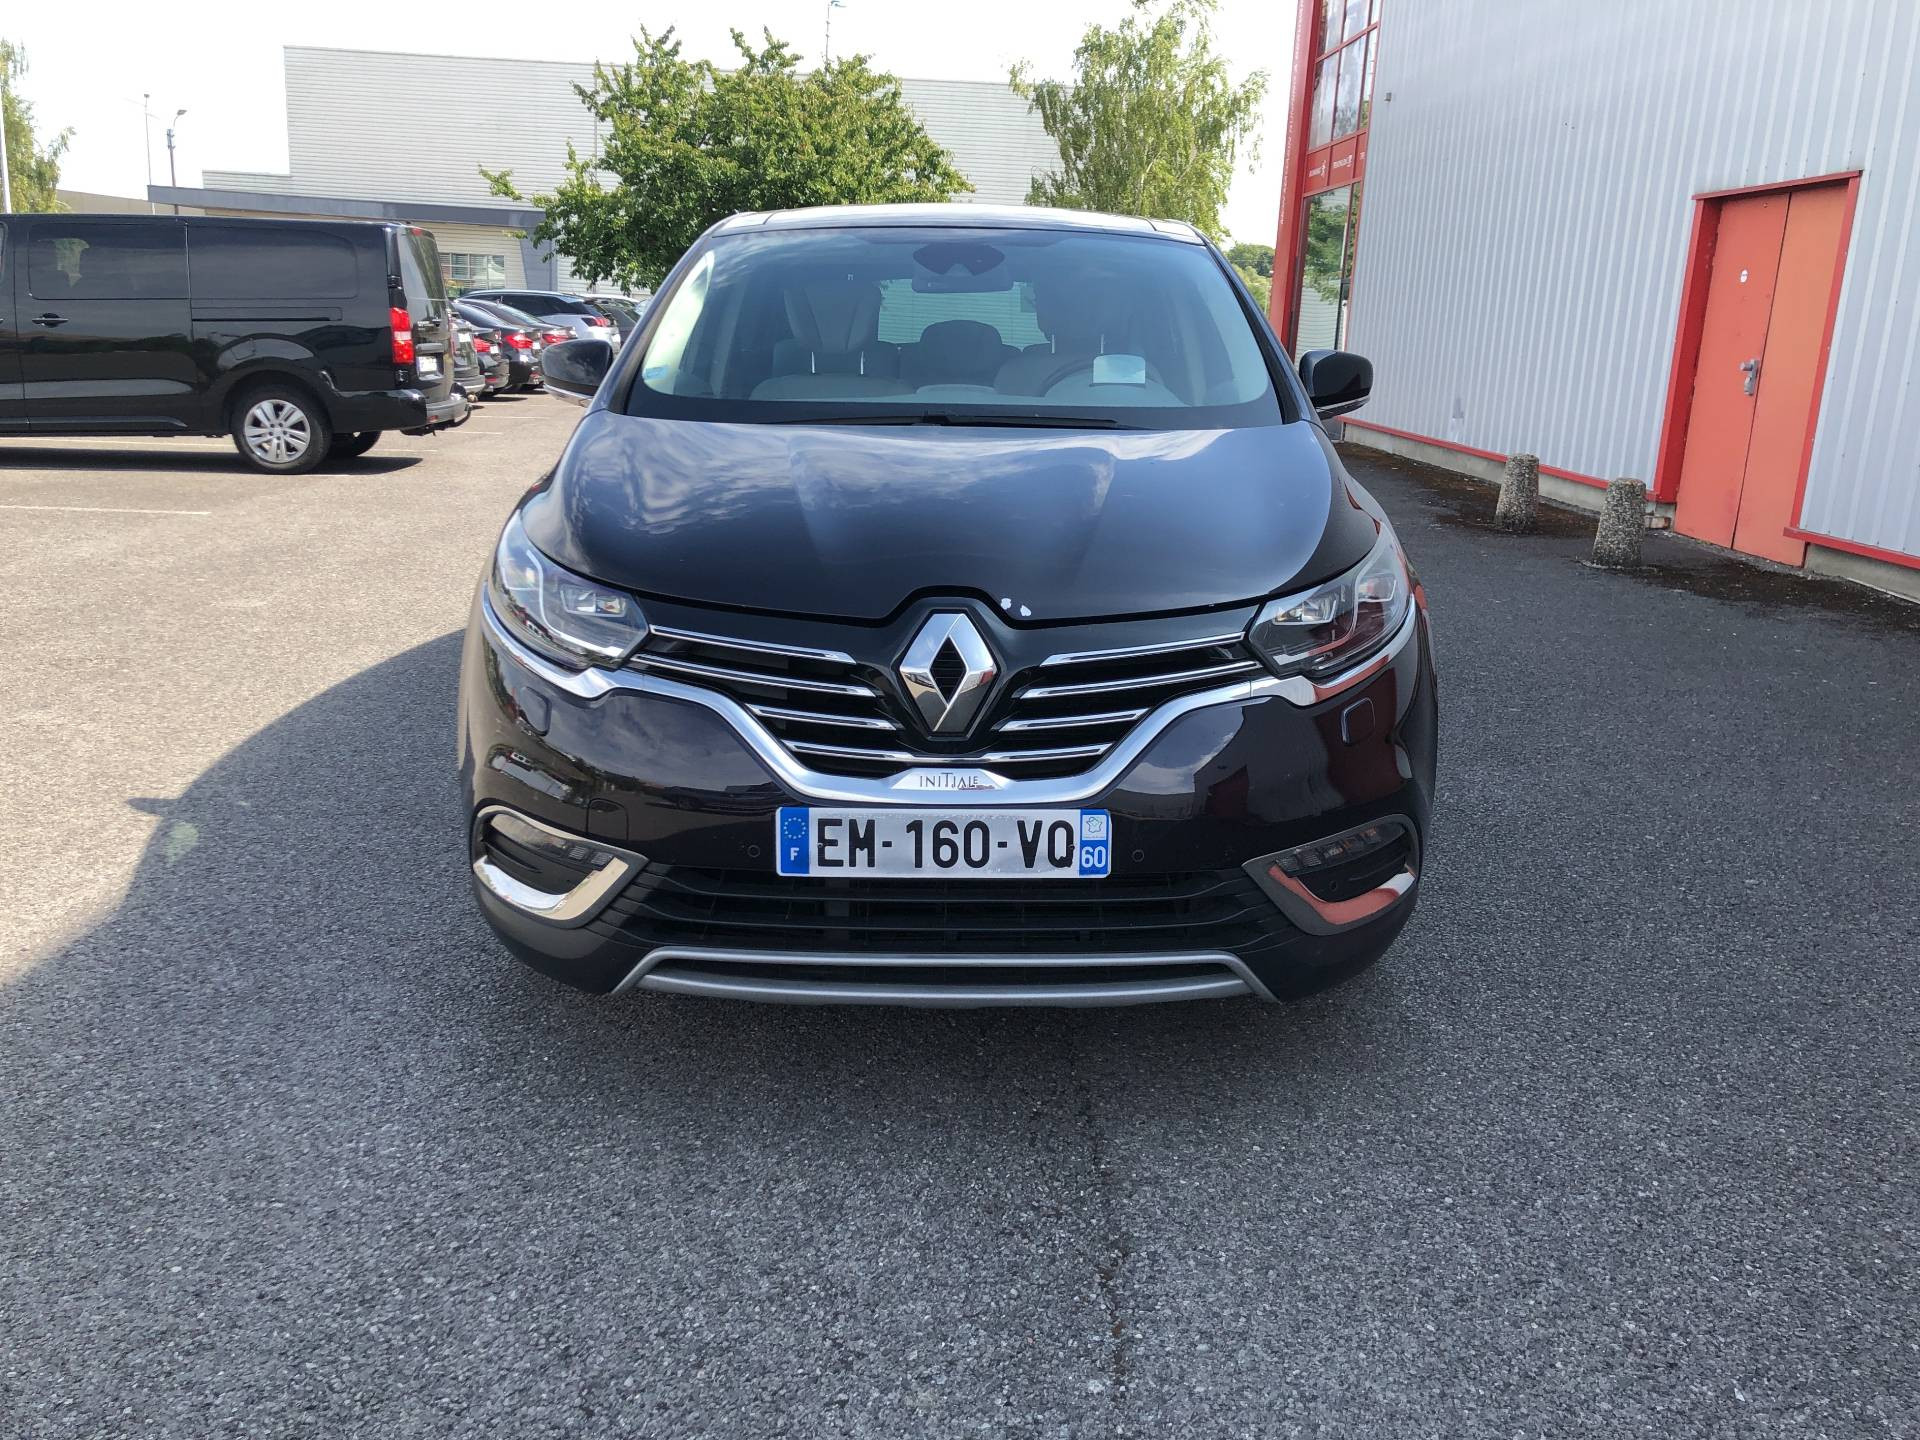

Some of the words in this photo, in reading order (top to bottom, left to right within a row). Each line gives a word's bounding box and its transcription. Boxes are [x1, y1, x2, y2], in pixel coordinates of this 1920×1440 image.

[920, 772, 978, 788] INITIALE
[817, 818, 1075, 868] EM-160-VQ
[790, 847, 800, 861] F
[1081, 845, 1106, 868] 60
